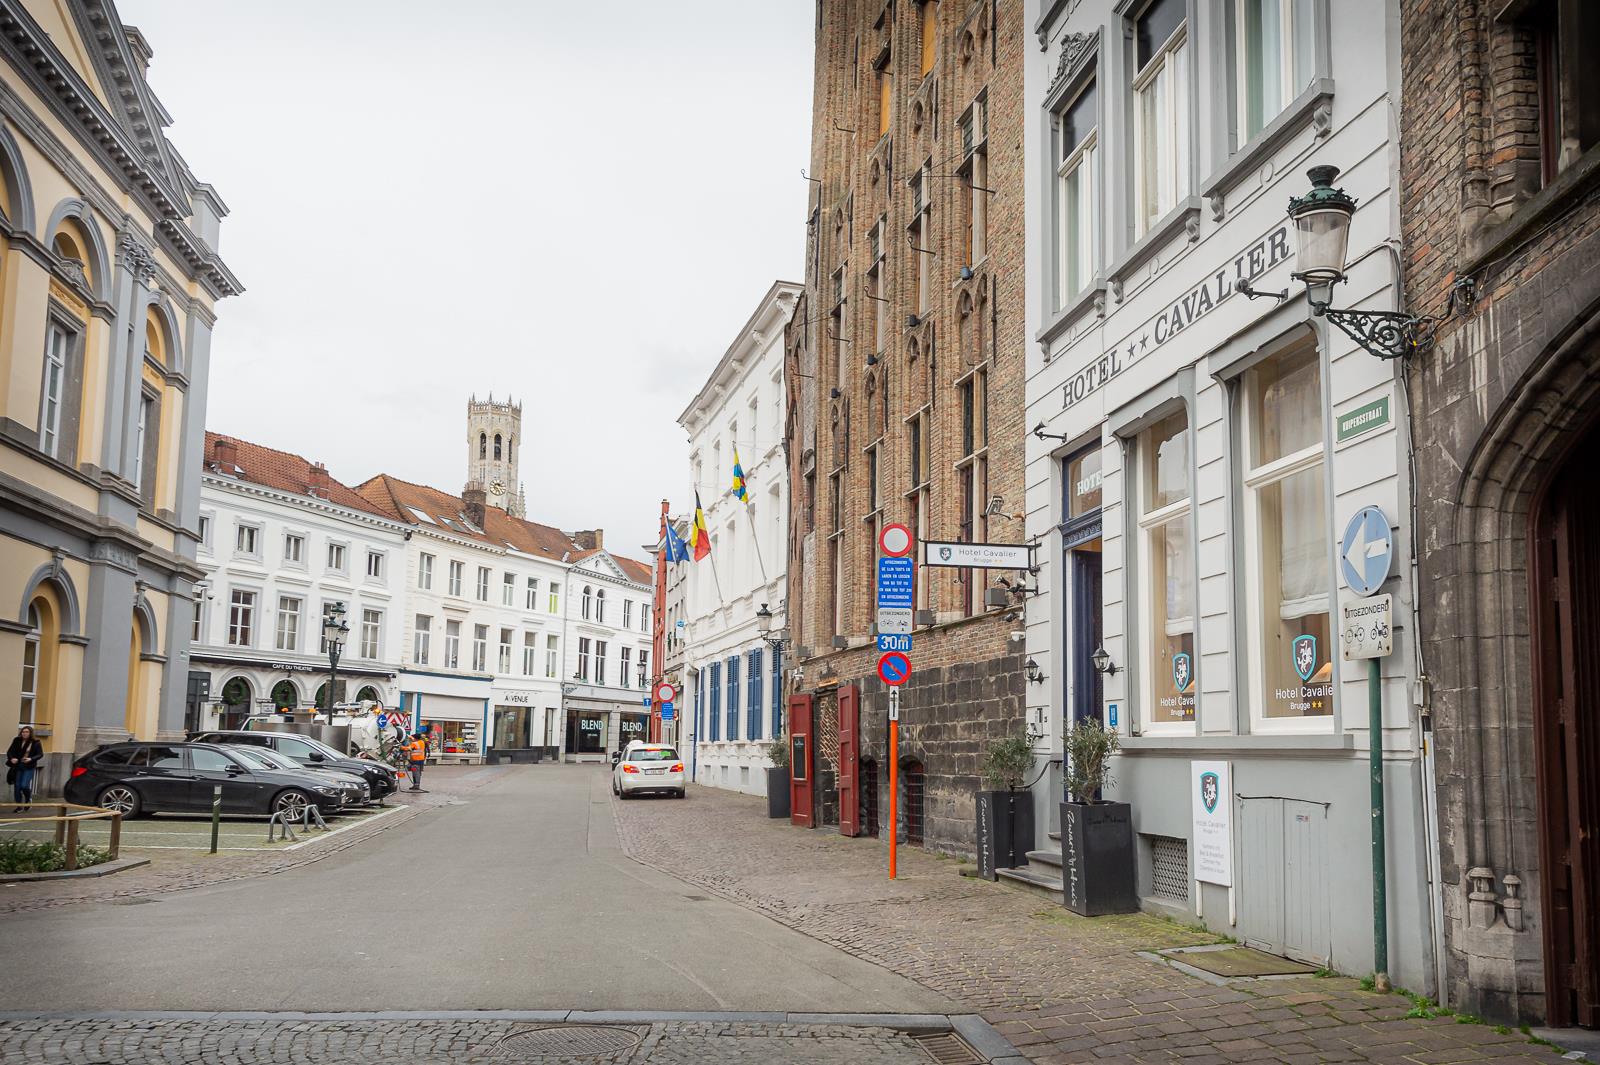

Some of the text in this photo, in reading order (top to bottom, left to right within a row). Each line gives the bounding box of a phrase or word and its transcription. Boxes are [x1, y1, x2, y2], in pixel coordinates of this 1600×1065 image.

[1062, 226, 1289, 409] HOTEL CAVALIER
[959, 548, 1017, 557] Hotel Cavalier
[1344, 603, 1389, 619] UITGEZONDERD
[880, 635, 909, 650] 30m
[1377, 640, 1383, 651] A
[1275, 687, 1298, 700] Hotel
[1160, 696, 1177, 707] Hotel
[1290, 701, 1311, 711] Brugge
[581, 719, 604, 730] BLEND
[622, 721, 643, 732] BLEND
